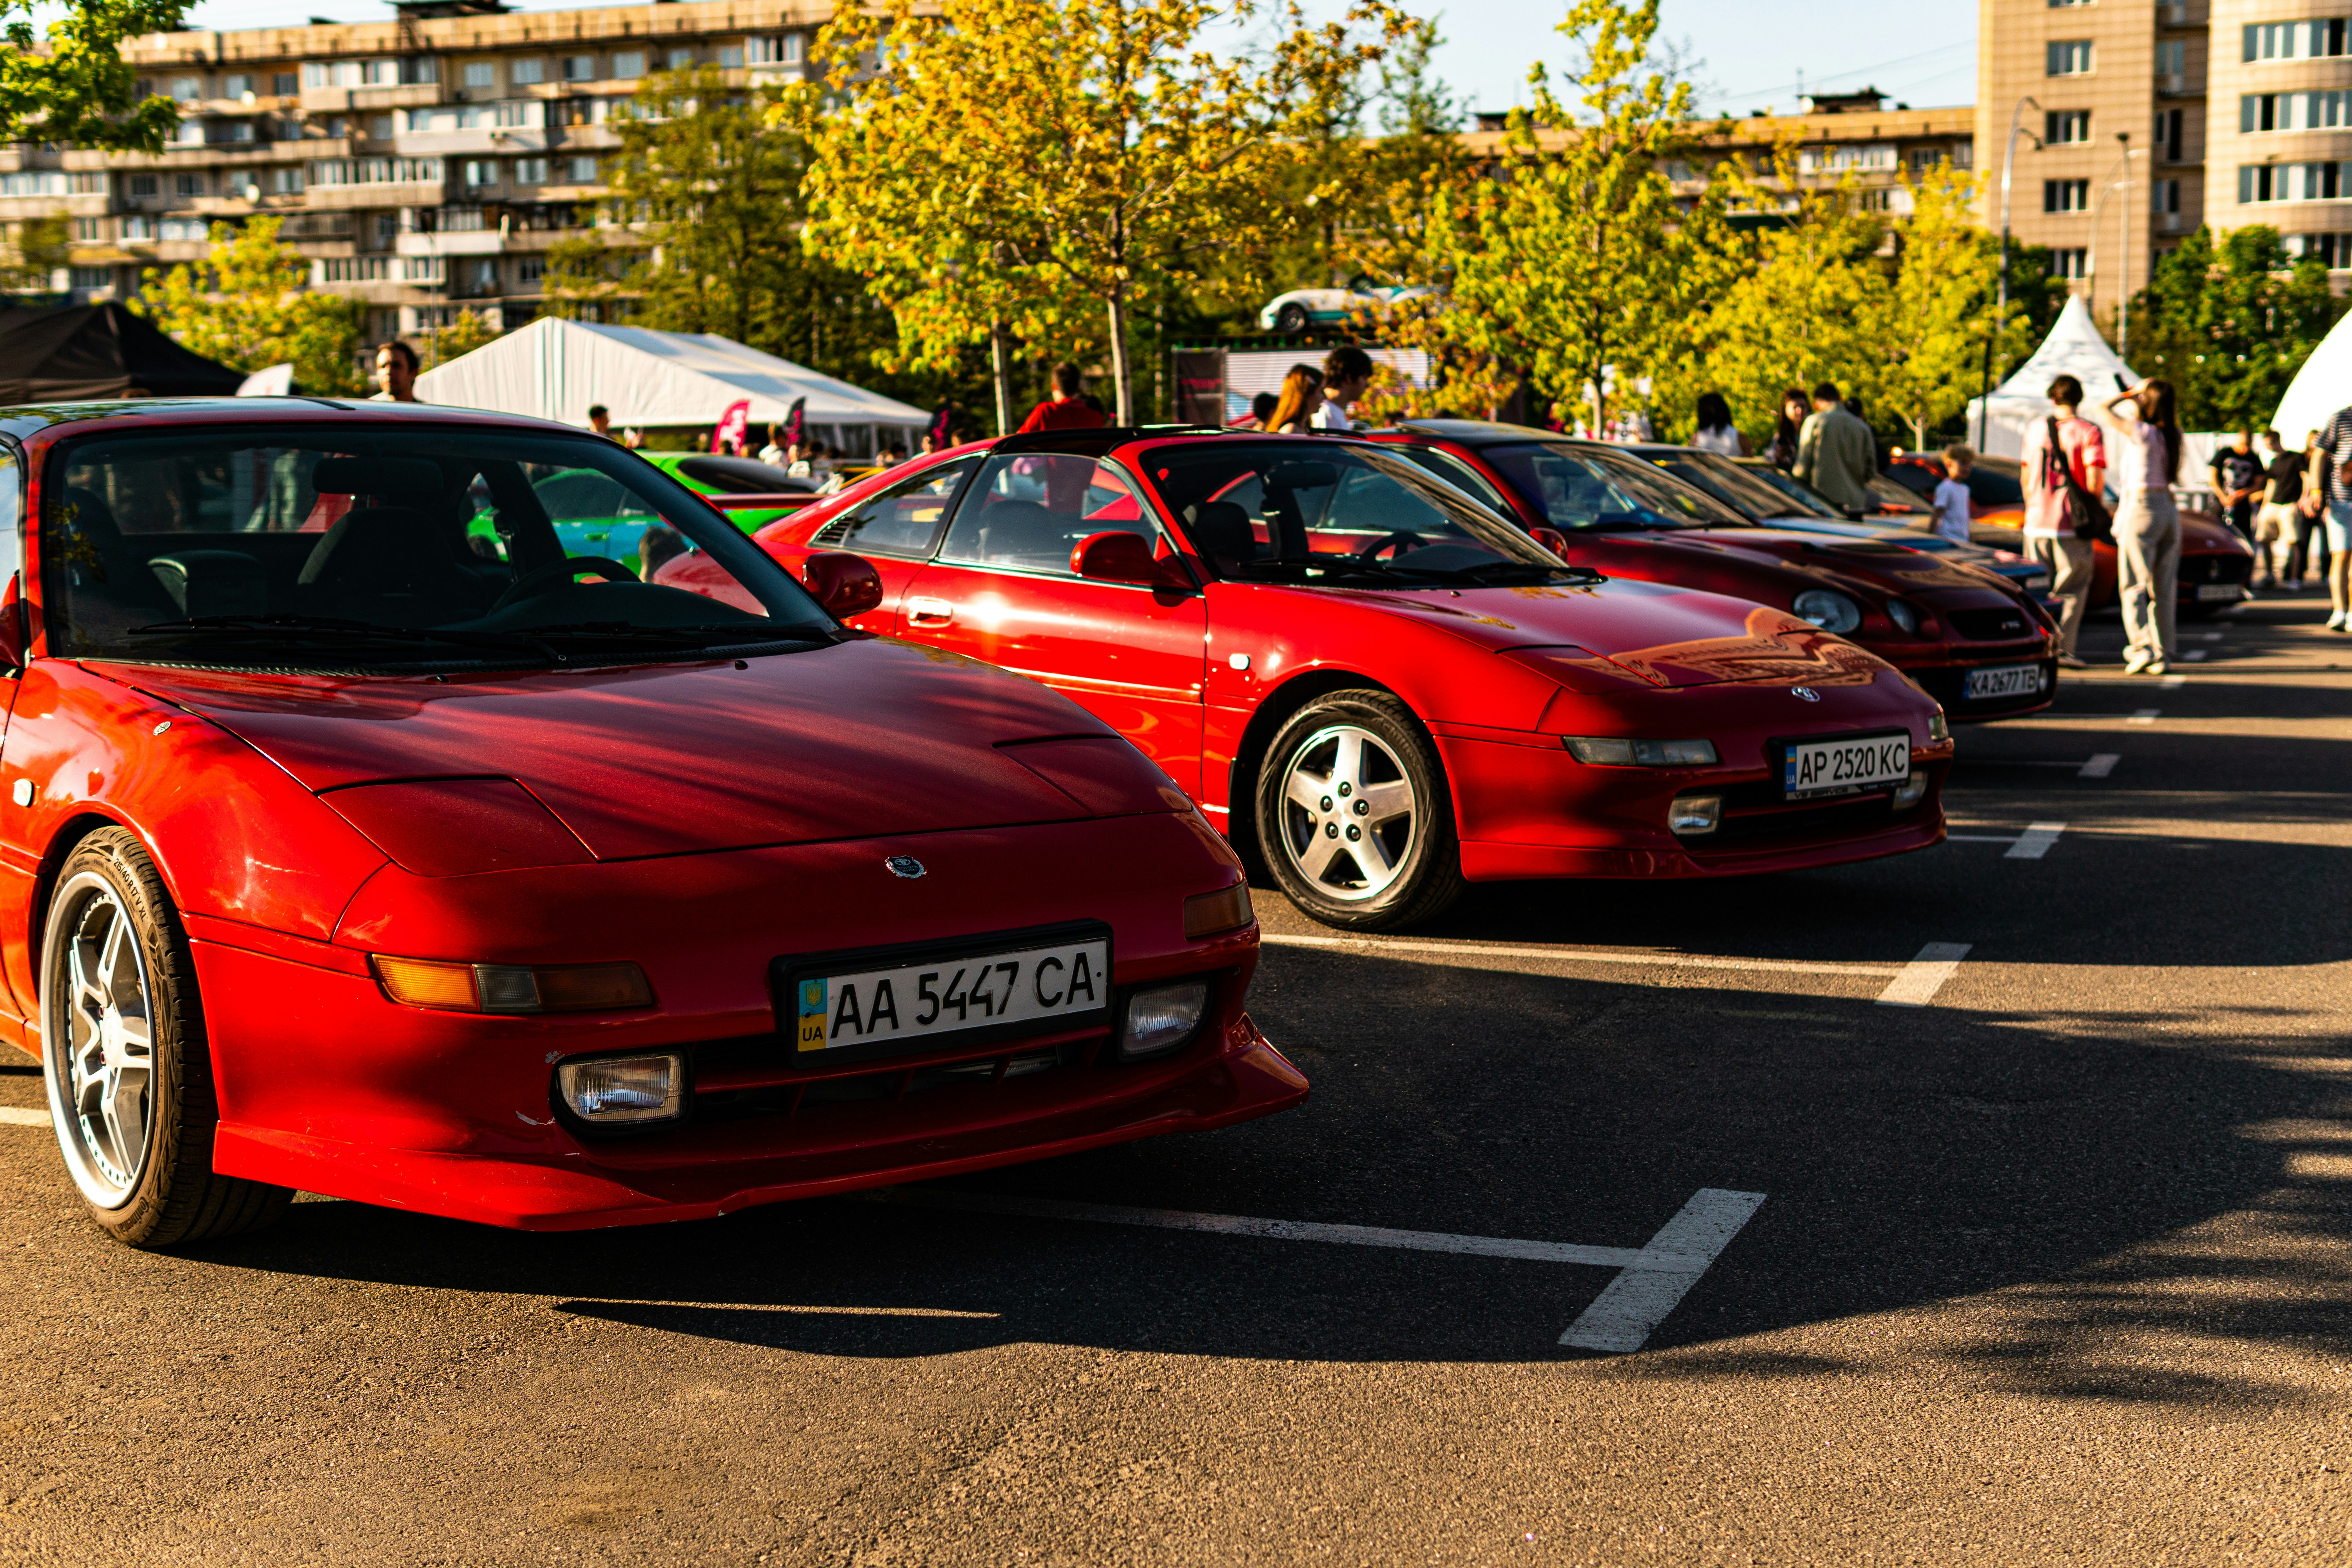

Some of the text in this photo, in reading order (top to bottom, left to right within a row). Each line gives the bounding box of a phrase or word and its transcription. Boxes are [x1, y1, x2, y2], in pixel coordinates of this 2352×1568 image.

[1970, 673, 1989, 695] KA
[1991, 671, 2019, 693] 2677
[1799, 742, 1906, 784] AP 2520 KC
[1786, 775, 1795, 784] UA
[113, 858, 130, 882] 215/40
[127, 880, 133, 889] R
[131, 886, 139, 897] 17
[135, 897, 142, 906] V
[138, 906, 147, 922] XL
[829, 951, 1095, 1038] AA 5447 CA
[802, 1025, 824, 1042] UA
